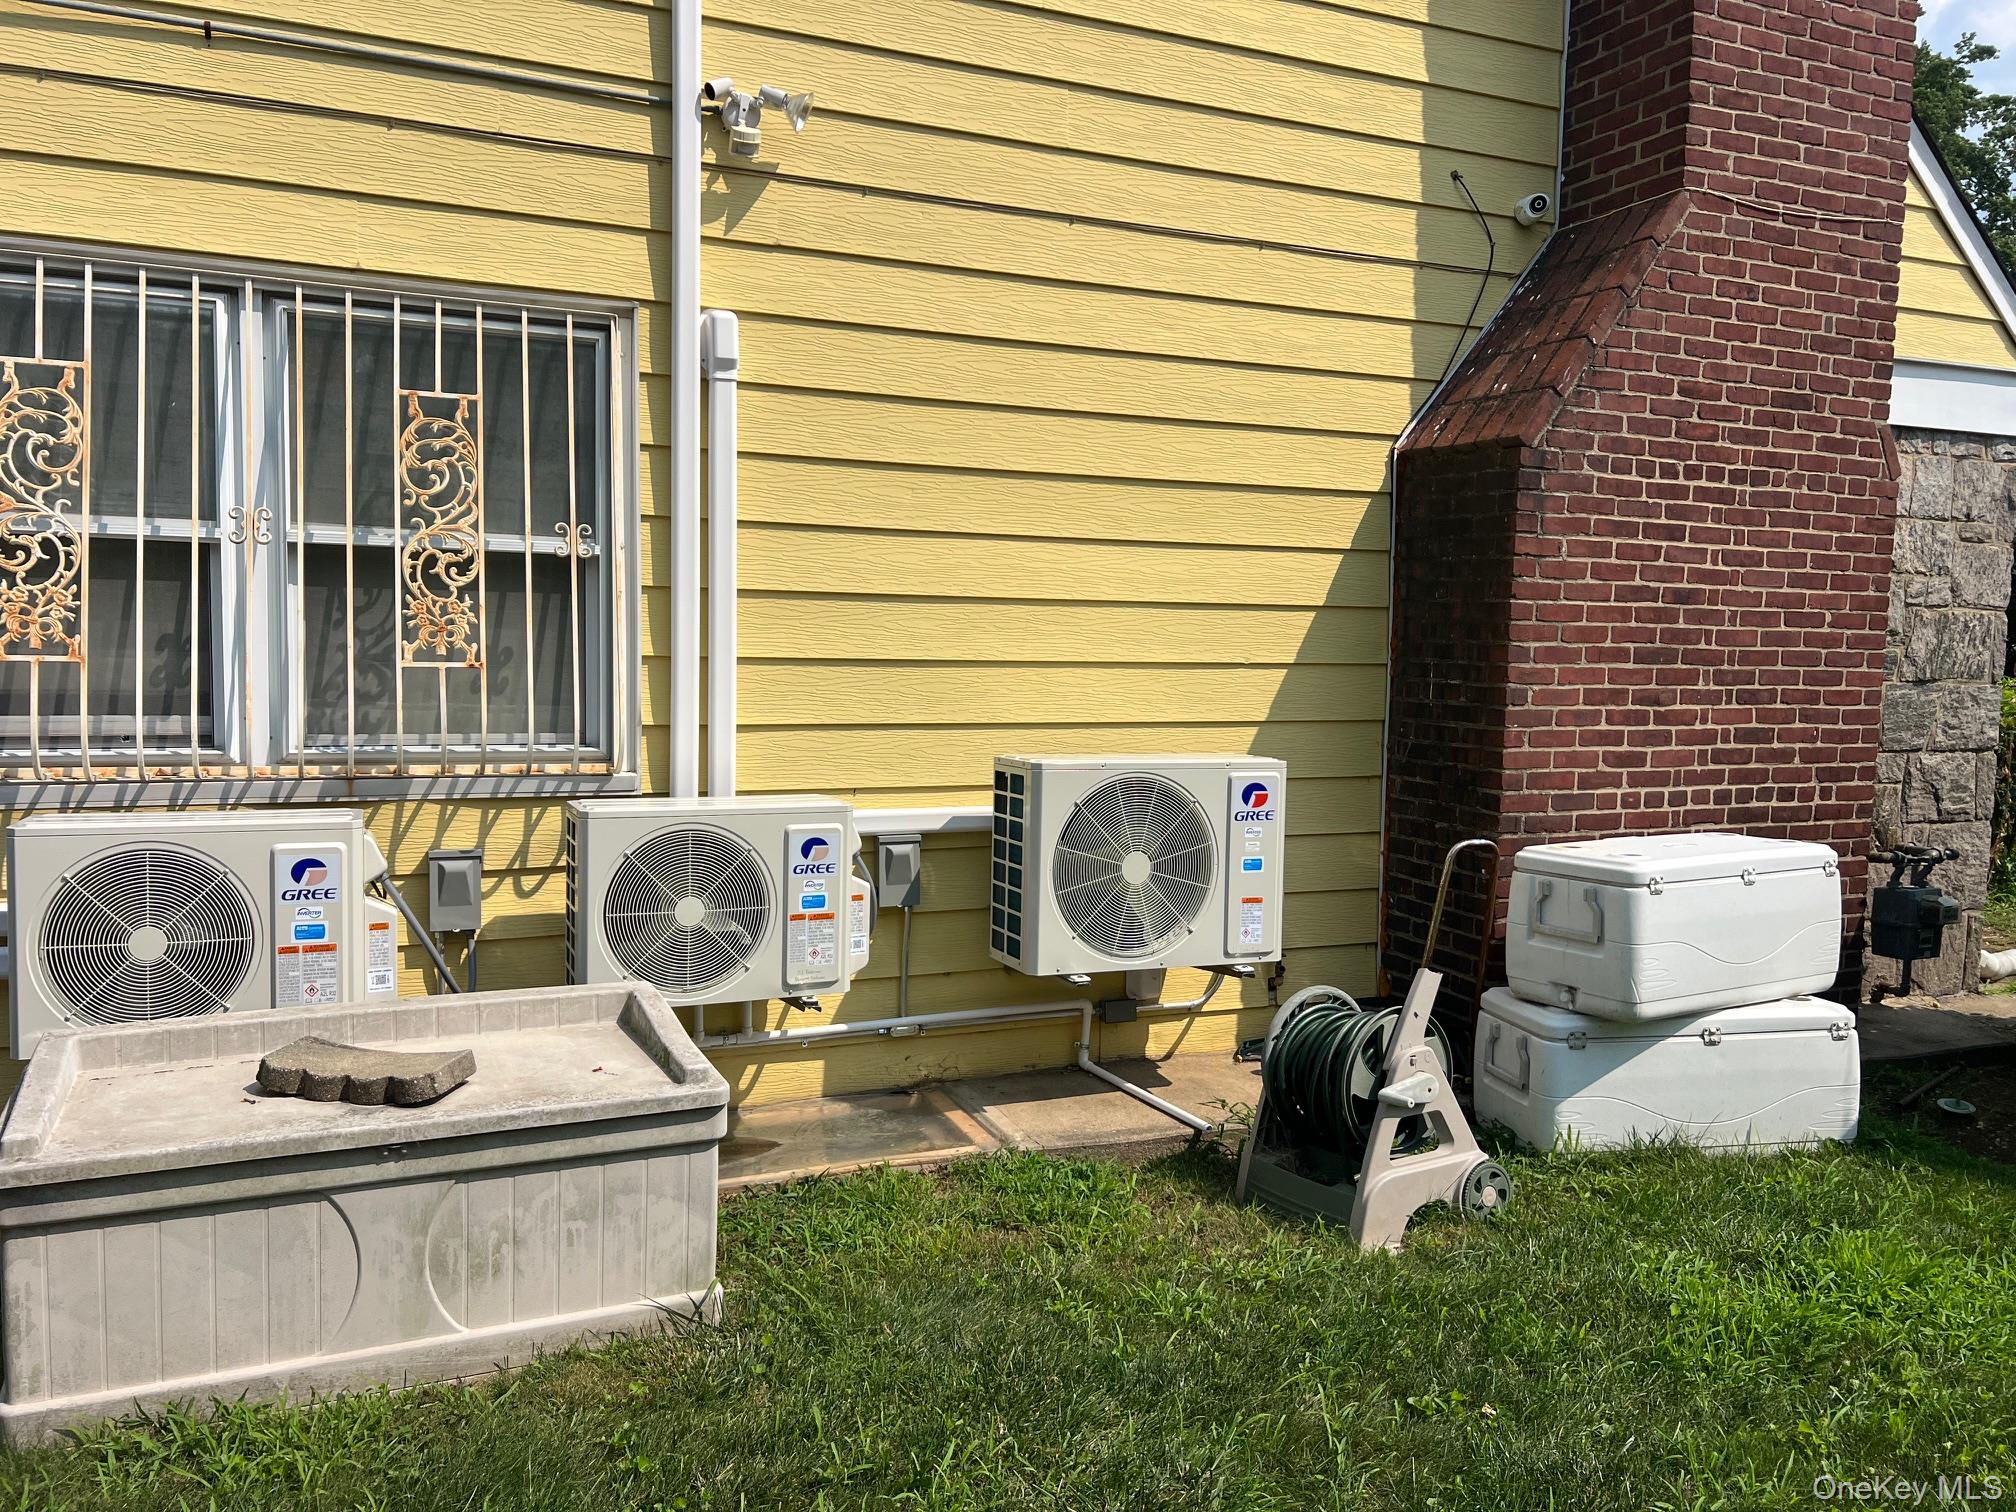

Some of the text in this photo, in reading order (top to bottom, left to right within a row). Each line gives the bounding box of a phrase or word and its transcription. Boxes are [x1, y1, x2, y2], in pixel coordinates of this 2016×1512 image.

[1234, 810, 1275, 822] GREE
[792, 863, 836, 875] GREE
[281, 888, 337, 901] GREE
